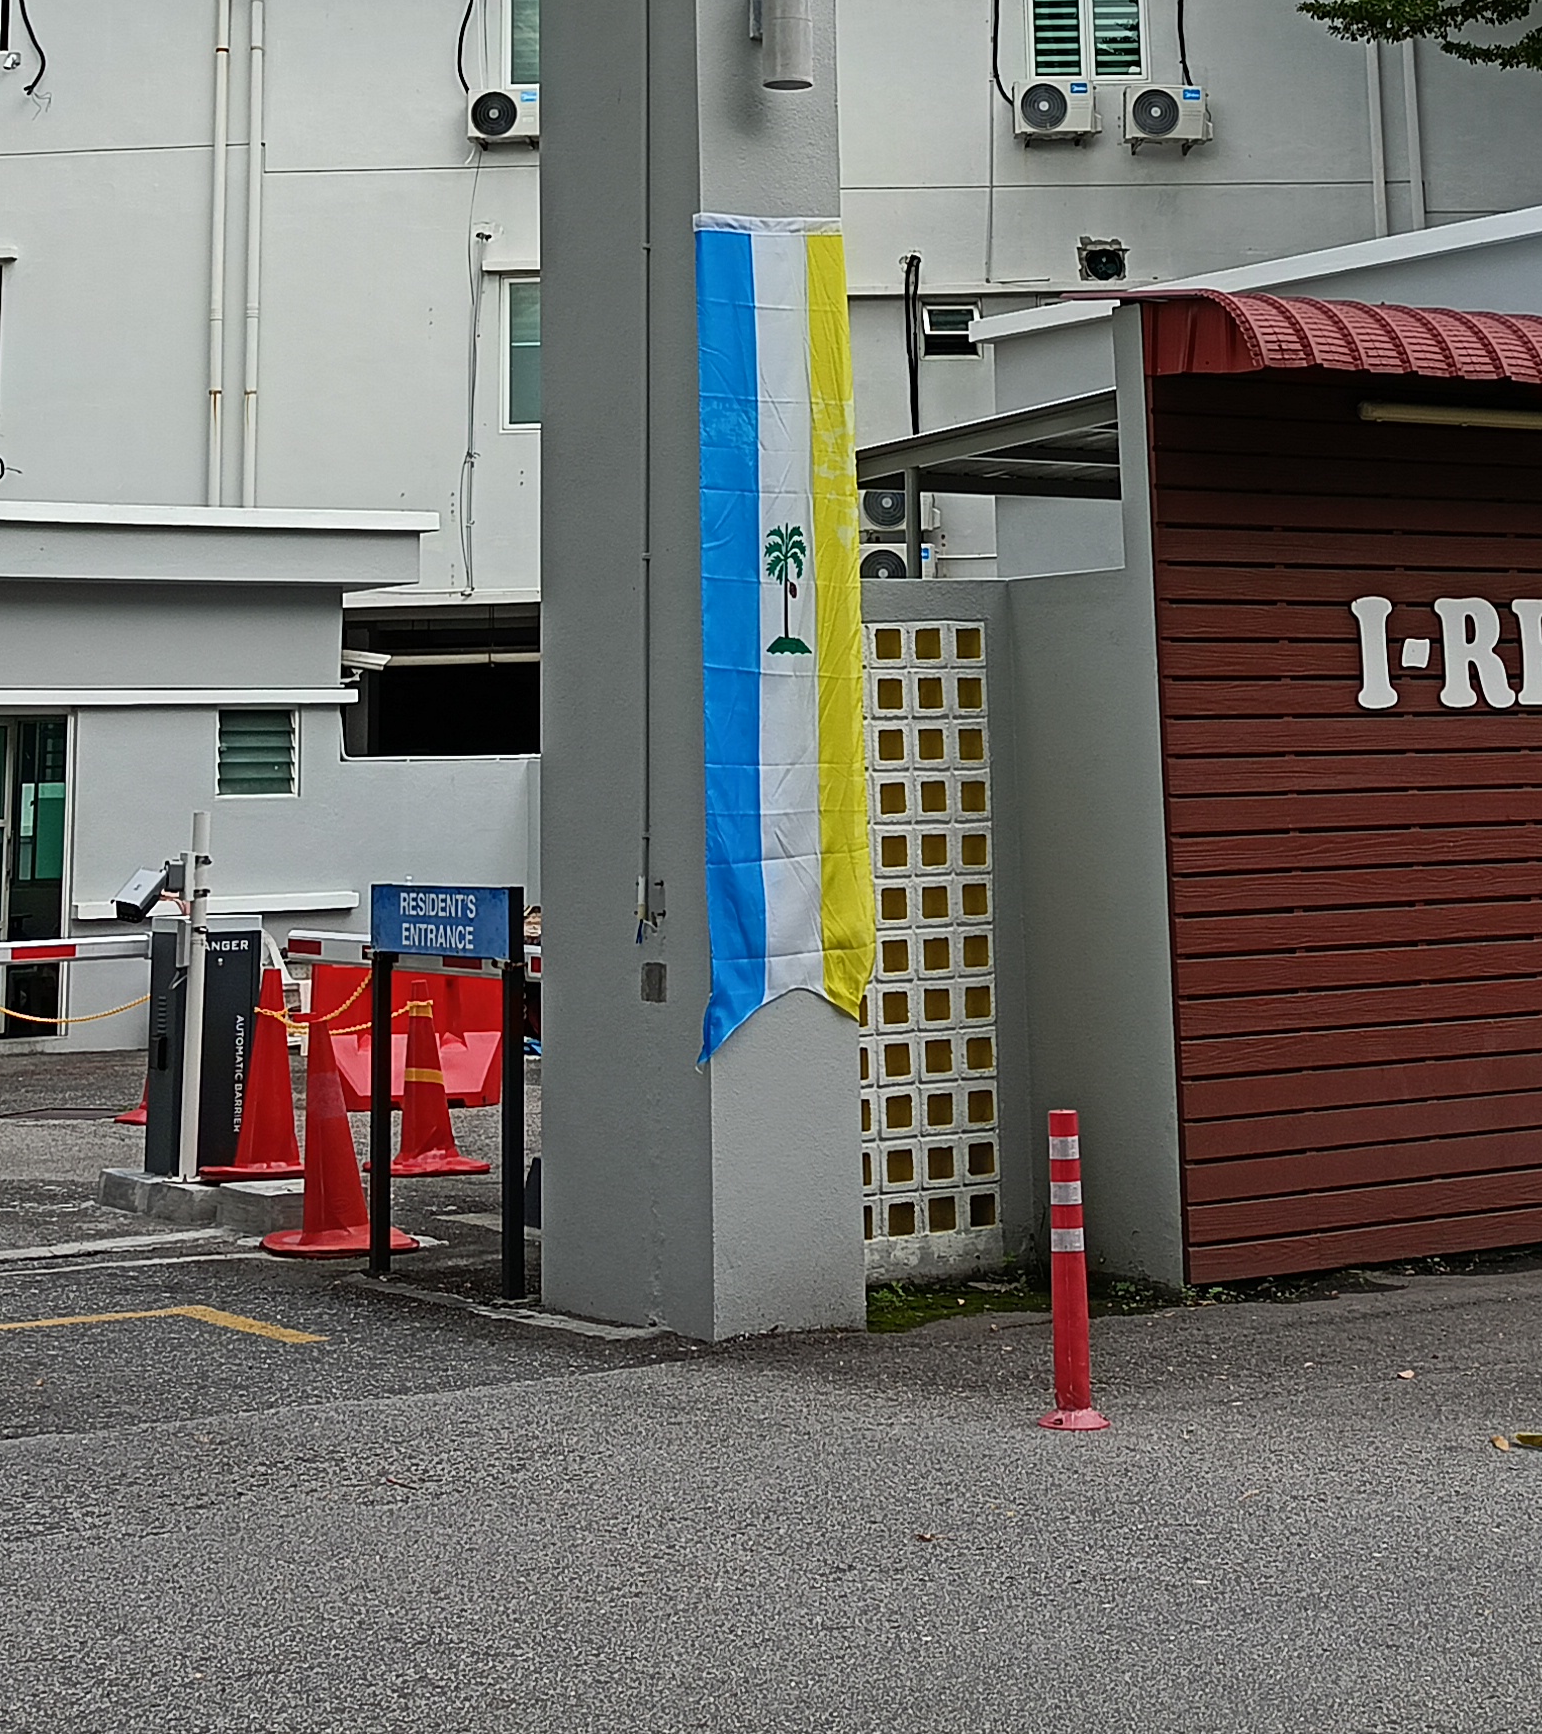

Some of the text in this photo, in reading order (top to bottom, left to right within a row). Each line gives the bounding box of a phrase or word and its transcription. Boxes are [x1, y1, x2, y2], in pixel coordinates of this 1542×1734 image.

[399, 892, 477, 919] RESIDENT'S
[205, 939, 249, 951] ANGER
[401, 922, 475, 950] ENTRANCE
[234, 1014, 245, 1081] AUTOMATIC
